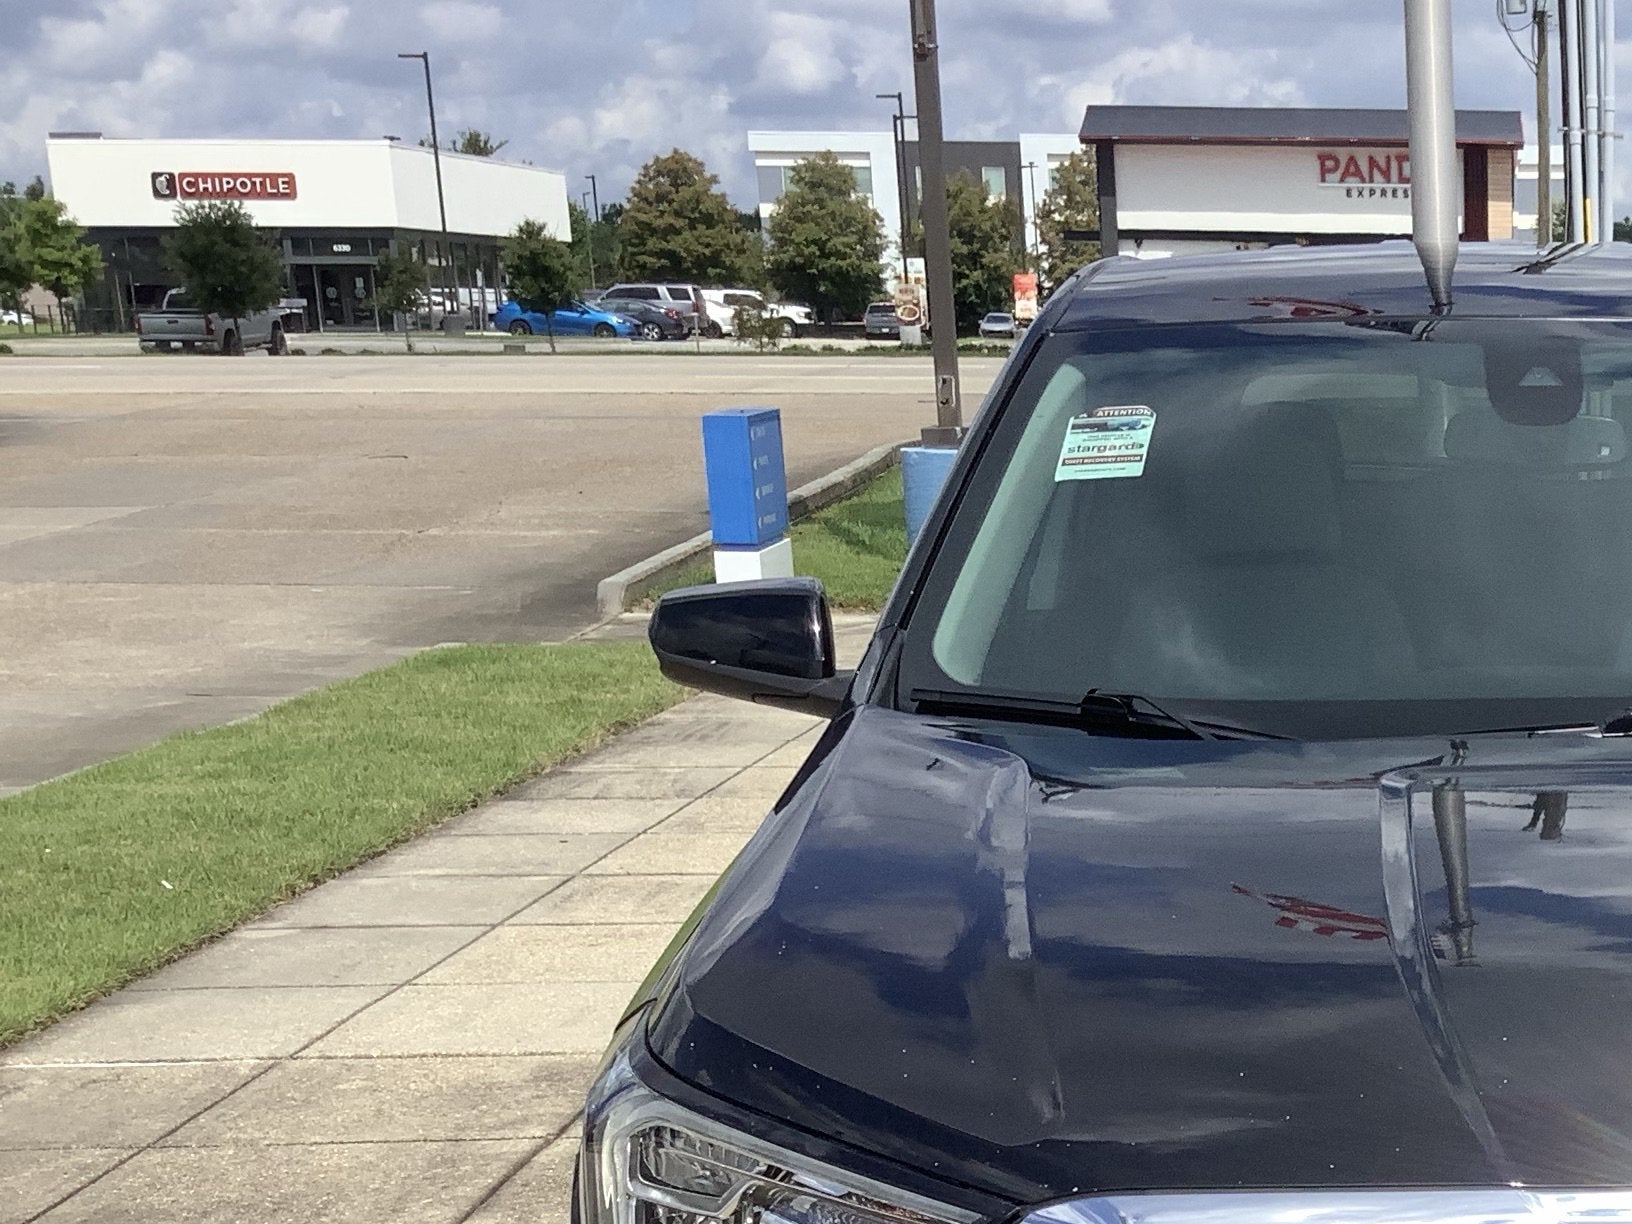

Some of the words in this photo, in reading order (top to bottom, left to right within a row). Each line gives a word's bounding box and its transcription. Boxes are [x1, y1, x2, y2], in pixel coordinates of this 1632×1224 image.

[1317, 153, 1412, 184] PAND
[182, 176, 291, 193] CHIPOTLE
[1346, 188, 1410, 199] EXPRES
[1096, 408, 1152, 417] ATTENTION
